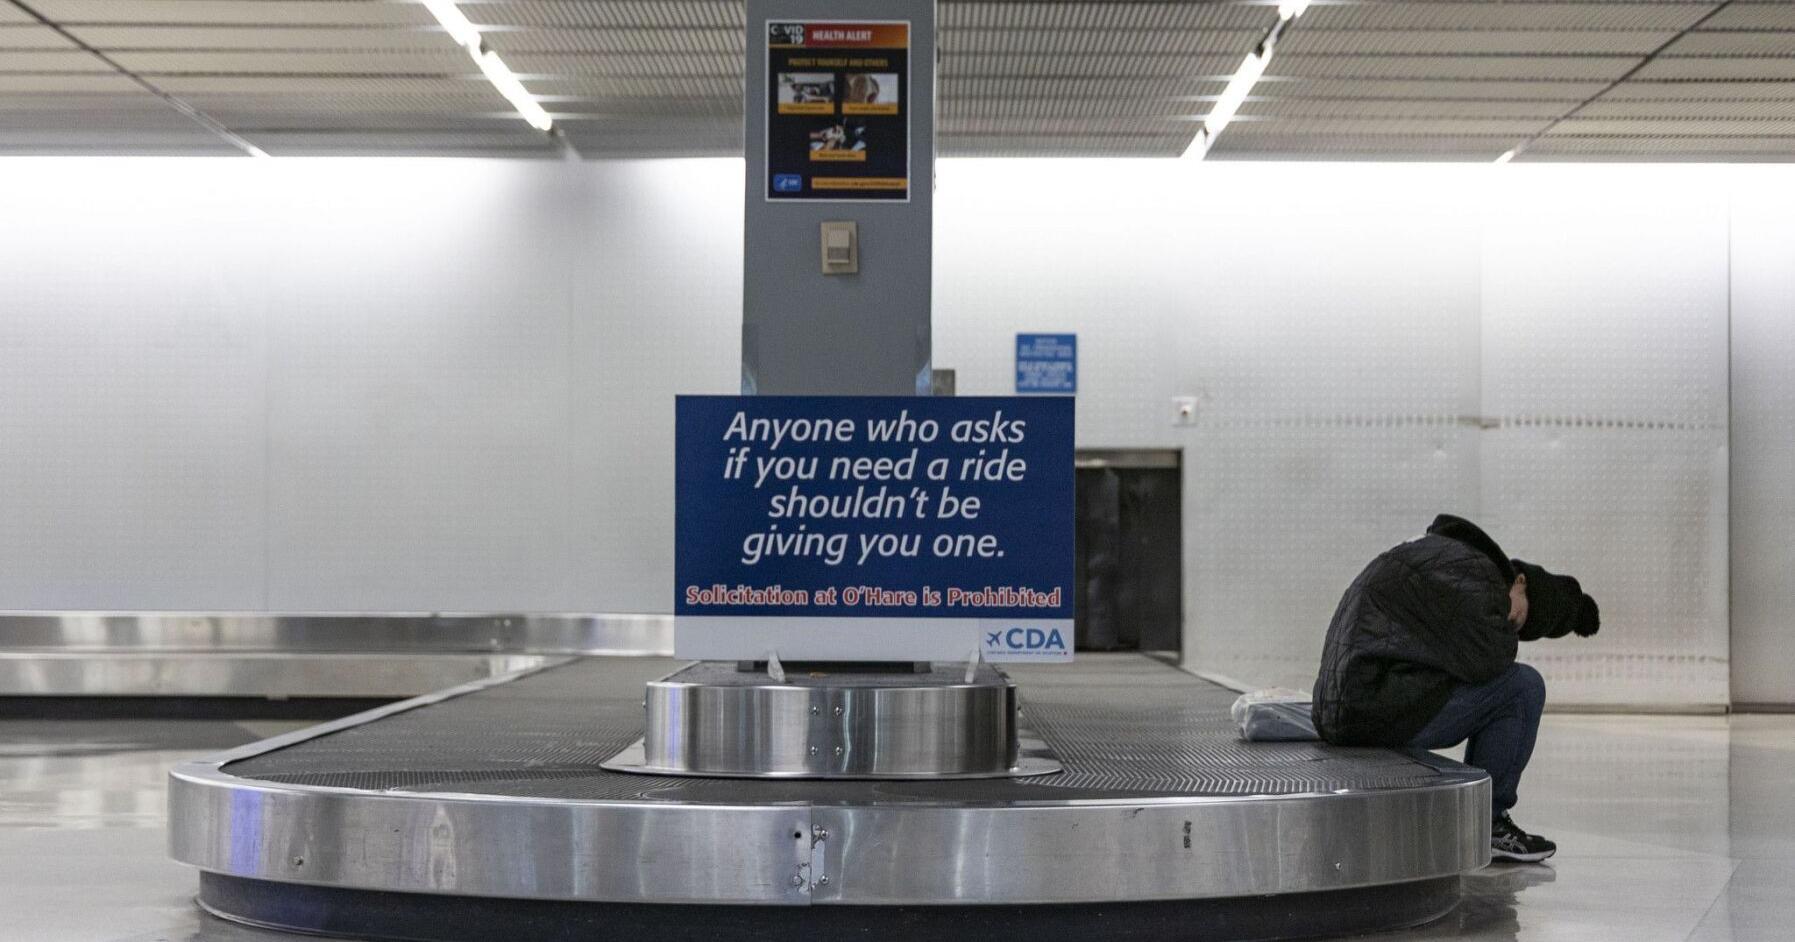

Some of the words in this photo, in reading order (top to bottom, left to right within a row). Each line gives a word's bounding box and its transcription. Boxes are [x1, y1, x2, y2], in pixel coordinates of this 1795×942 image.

[770, 24, 804, 35] CVID
[790, 34, 804, 44] 19
[812, 30, 845, 41] HEALTH
[846, 30, 872, 41] ALERT
[722, 411, 855, 451] Anyone
[867, 409, 939, 443] who
[950, 410, 1026, 444] asks
[723, 447, 749, 479] if
[754, 456, 819, 489] you
[829, 447, 919, 481] need
[926, 458, 950, 481] a
[959, 448, 1027, 482] ride
[768, 486, 929, 519] shouldn't
[937, 486, 981, 519] be
[741, 523, 849, 566] giving
[857, 533, 922, 566] you
[932, 534, 1005, 558] one.
[686, 584, 808, 606] Solicitation
[813, 587, 838, 606] at
[843, 586, 917, 607] O'Hare
[922, 586, 942, 607] is
[947, 586, 1062, 608] Prohibited
[1005, 627, 1065, 649] CDA
